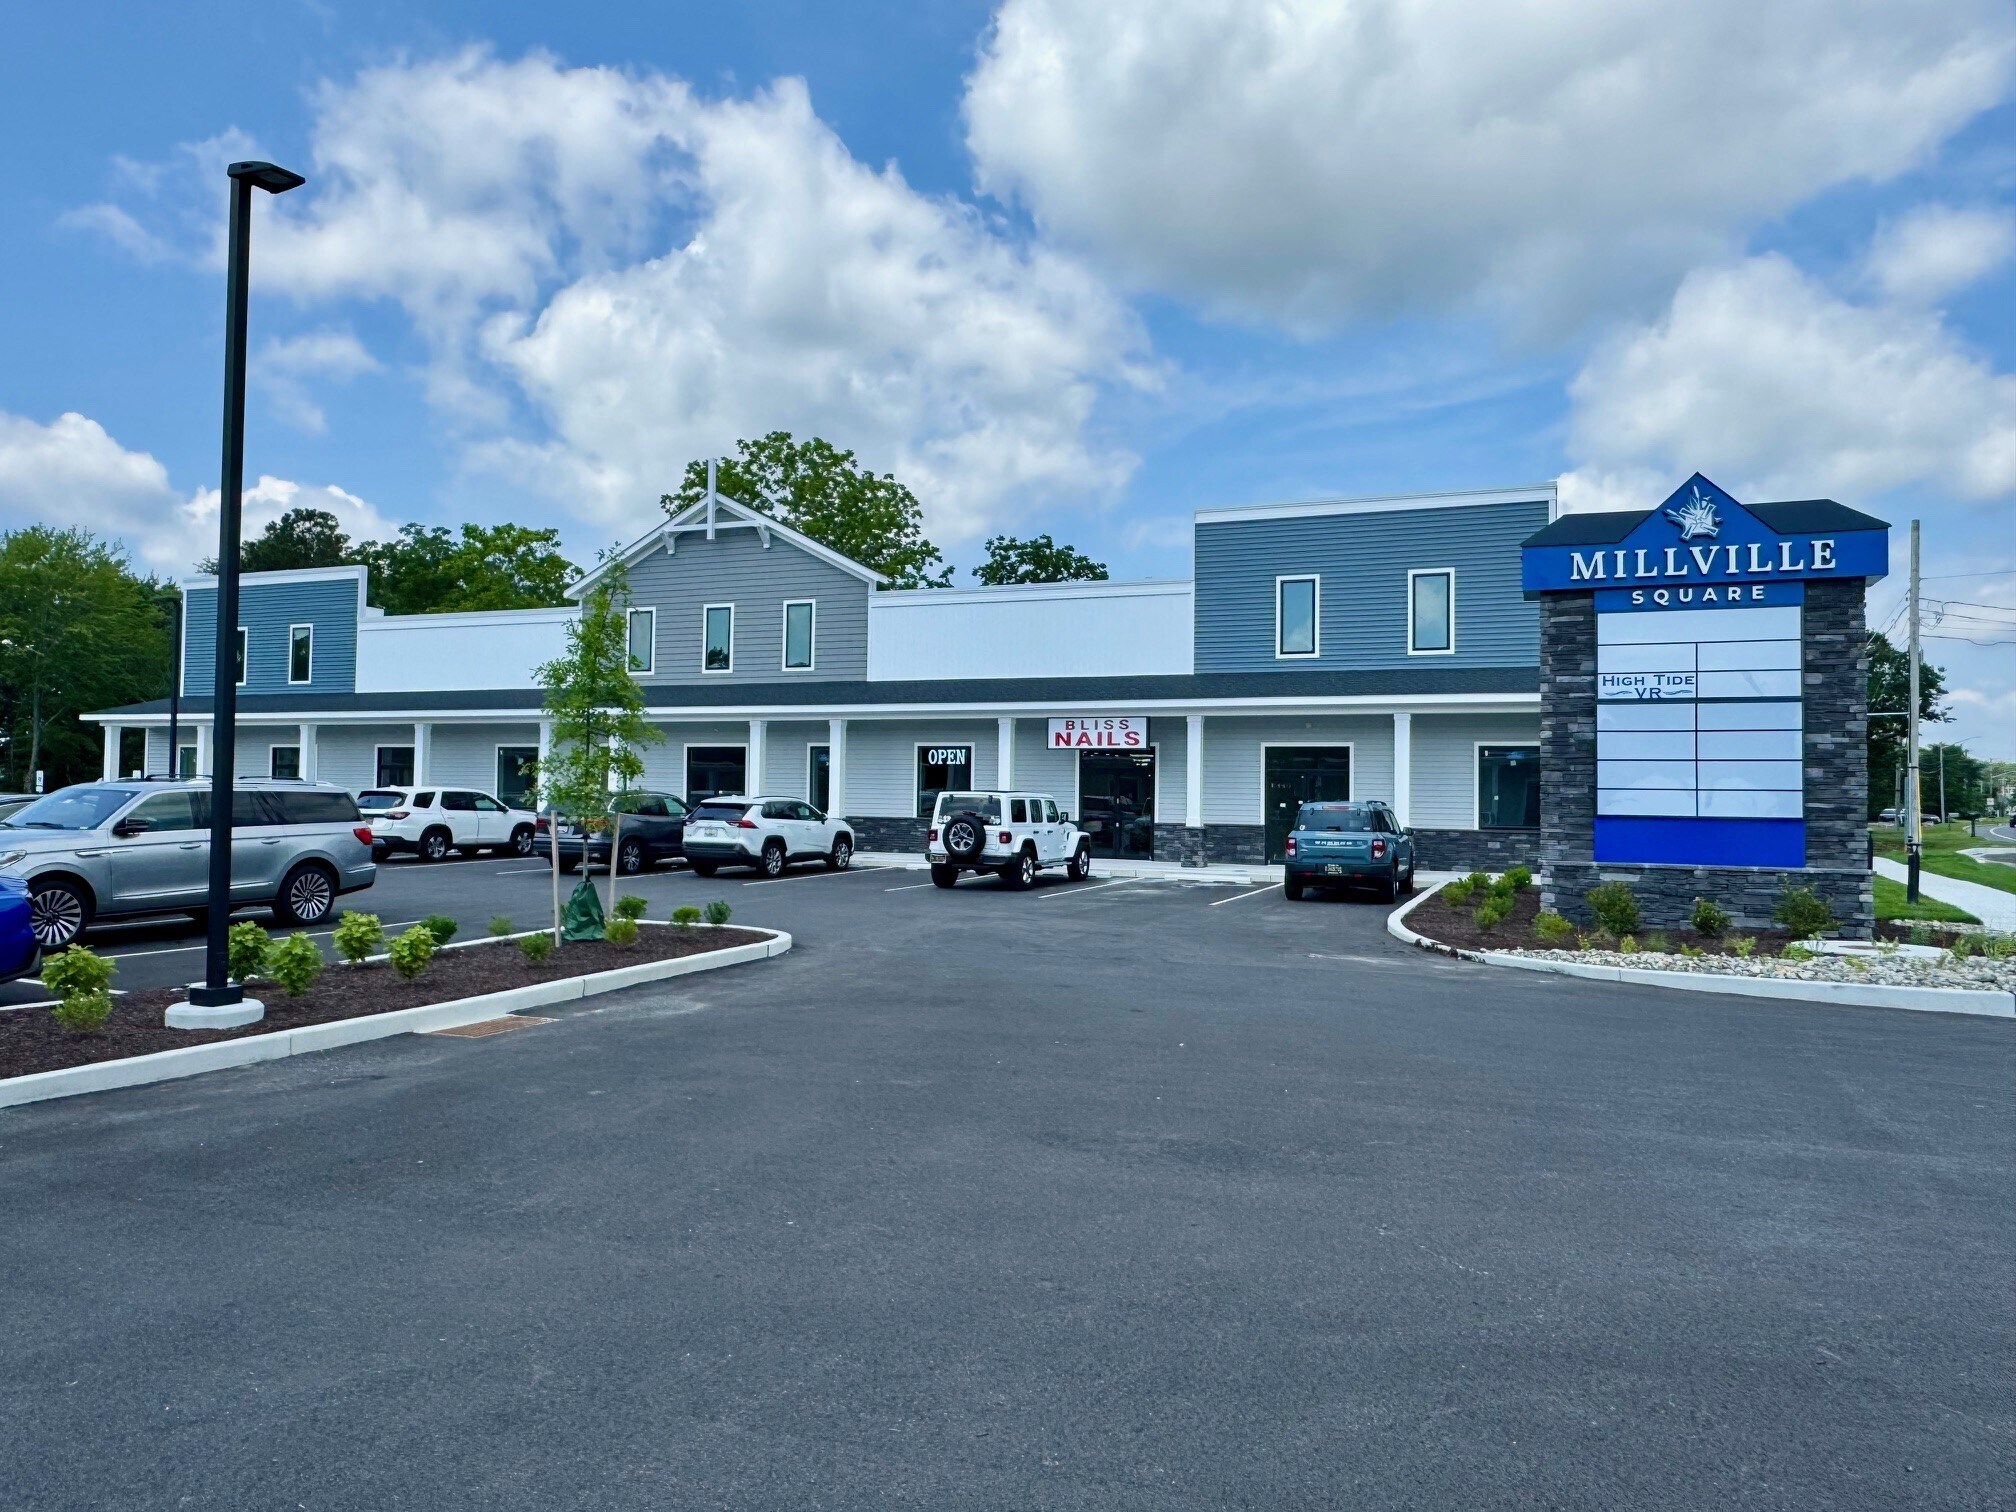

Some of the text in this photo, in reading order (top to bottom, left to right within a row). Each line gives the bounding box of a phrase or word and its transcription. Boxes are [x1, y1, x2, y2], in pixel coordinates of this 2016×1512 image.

[1570, 539, 1836, 580] MILLVILLE
[1632, 585, 1765, 605] SQUARE
[1602, 674, 1695, 686] HIGH TIDE
[1634, 687, 1662, 699] VR
[1065, 719, 1130, 730] BLISS
[1055, 731, 1140, 746] NAILS
[928, 749, 966, 765] OPEN
